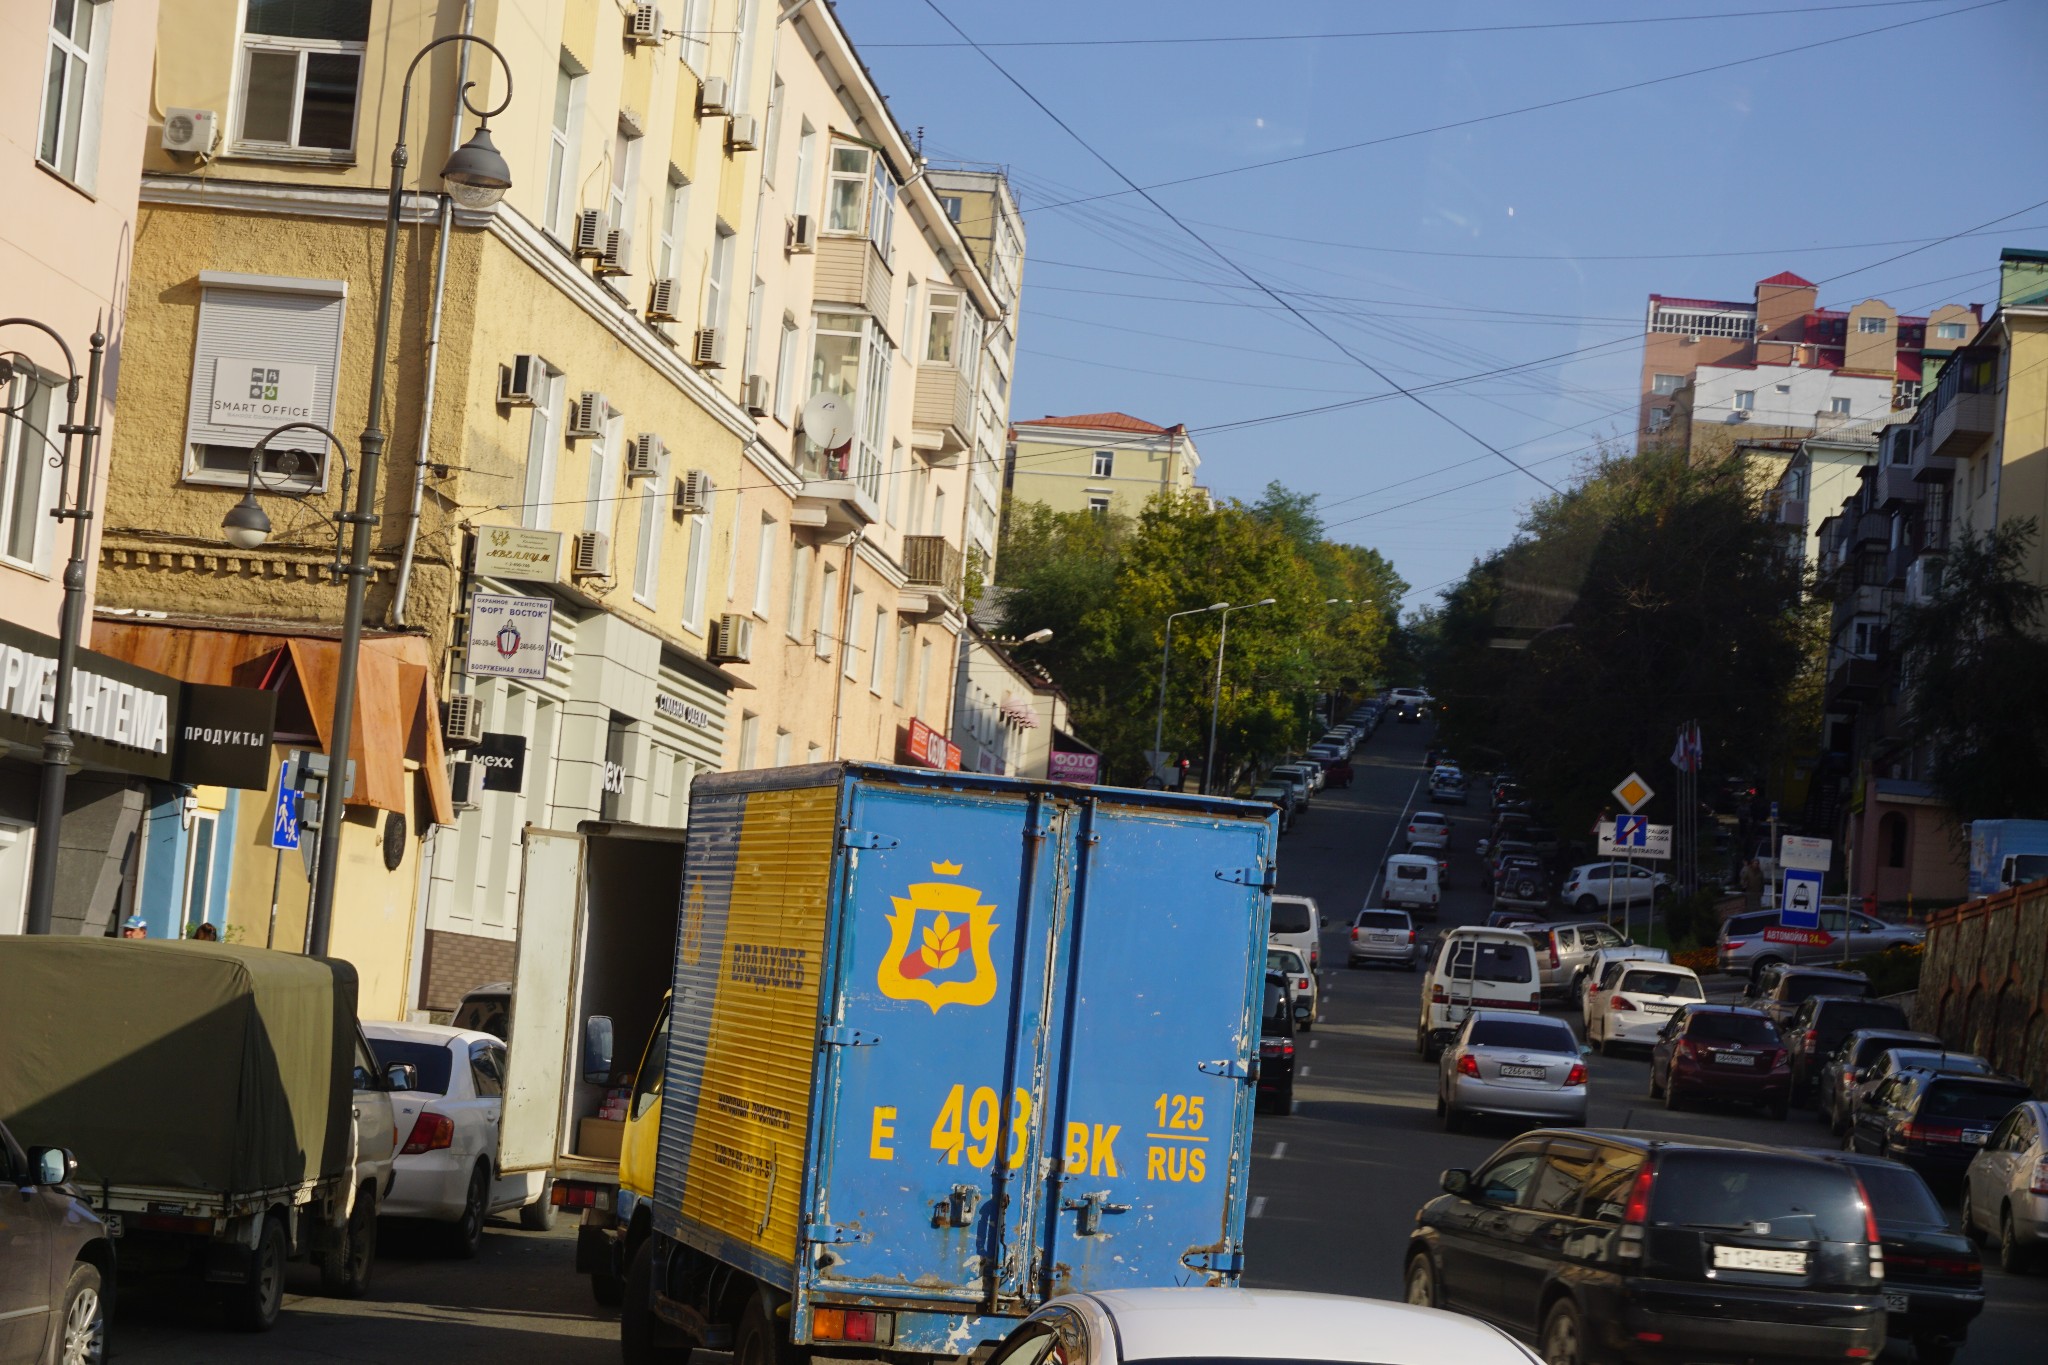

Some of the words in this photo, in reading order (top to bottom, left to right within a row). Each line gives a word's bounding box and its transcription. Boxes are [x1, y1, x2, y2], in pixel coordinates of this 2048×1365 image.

[214, 400, 256, 412] SMART
[262, 404, 309, 417] OFFICE
[513, 601, 548, 609] АГЕНТСТВО
[471, 664, 514, 673] ВООРУЖЕННАЯ
[0, 643, 168, 754] РИЗАНТЕМА
[184, 726, 264, 747] ПРОДУКТЫ
[1054, 753, 1096, 767] ФОТО
[1766, 930, 1808, 943] АВТОМОЙКА
[1808, 933, 1819, 943] 24
[1154, 1093, 1205, 1131] 125
[1147, 1146, 1206, 1183] RUS
[1886, 1295, 1905, 1306] 125
